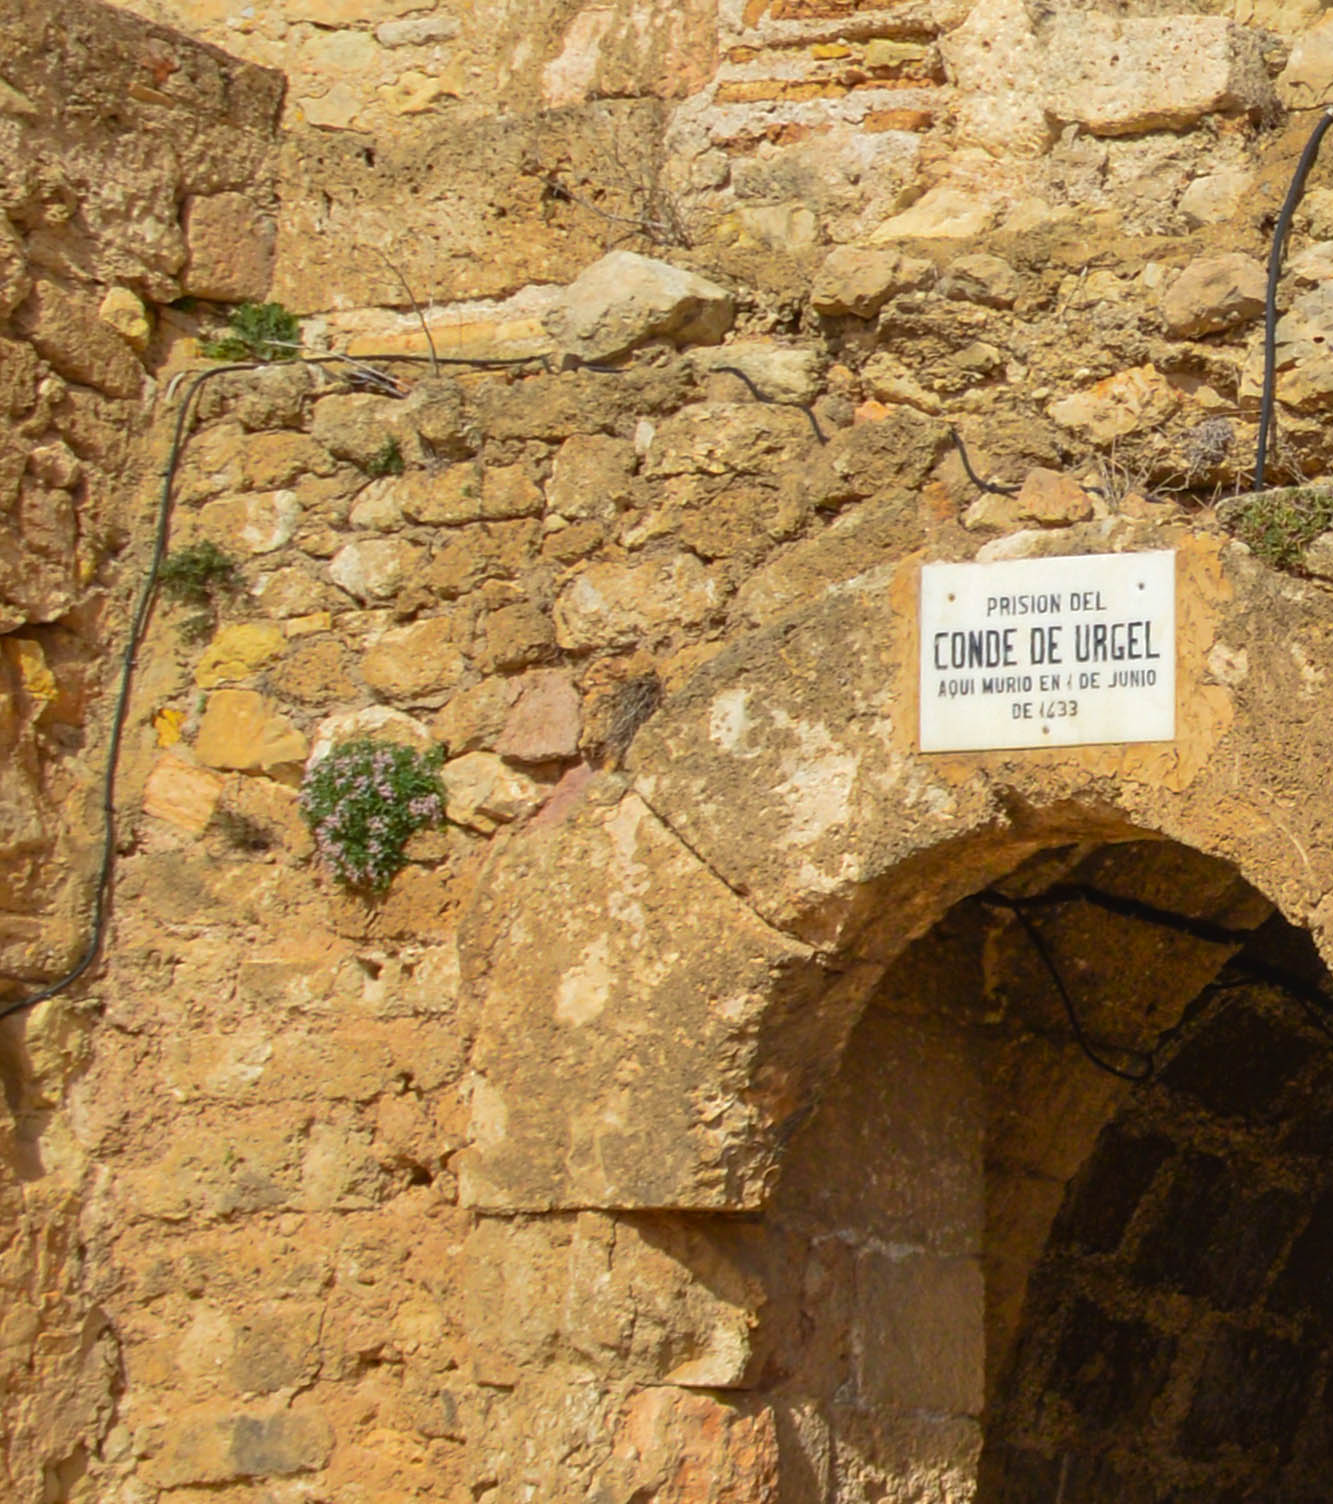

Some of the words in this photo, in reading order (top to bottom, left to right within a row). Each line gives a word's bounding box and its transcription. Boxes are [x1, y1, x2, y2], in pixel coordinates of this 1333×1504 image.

[986, 594, 1062, 617] PRISION
[1070, 591, 1107, 611] DEL
[934, 627, 1018, 670] CONDE
[1030, 626, 1063, 664] DE
[1075, 620, 1160, 663] URGEL
[938, 678, 975, 699] AQUI
[982, 675, 1032, 694] MURIO
[1040, 674, 1060, 692] EN
[1079, 672, 1101, 690] DE
[1108, 669, 1157, 689] JUNIO
[1012, 702, 1033, 719] DE
